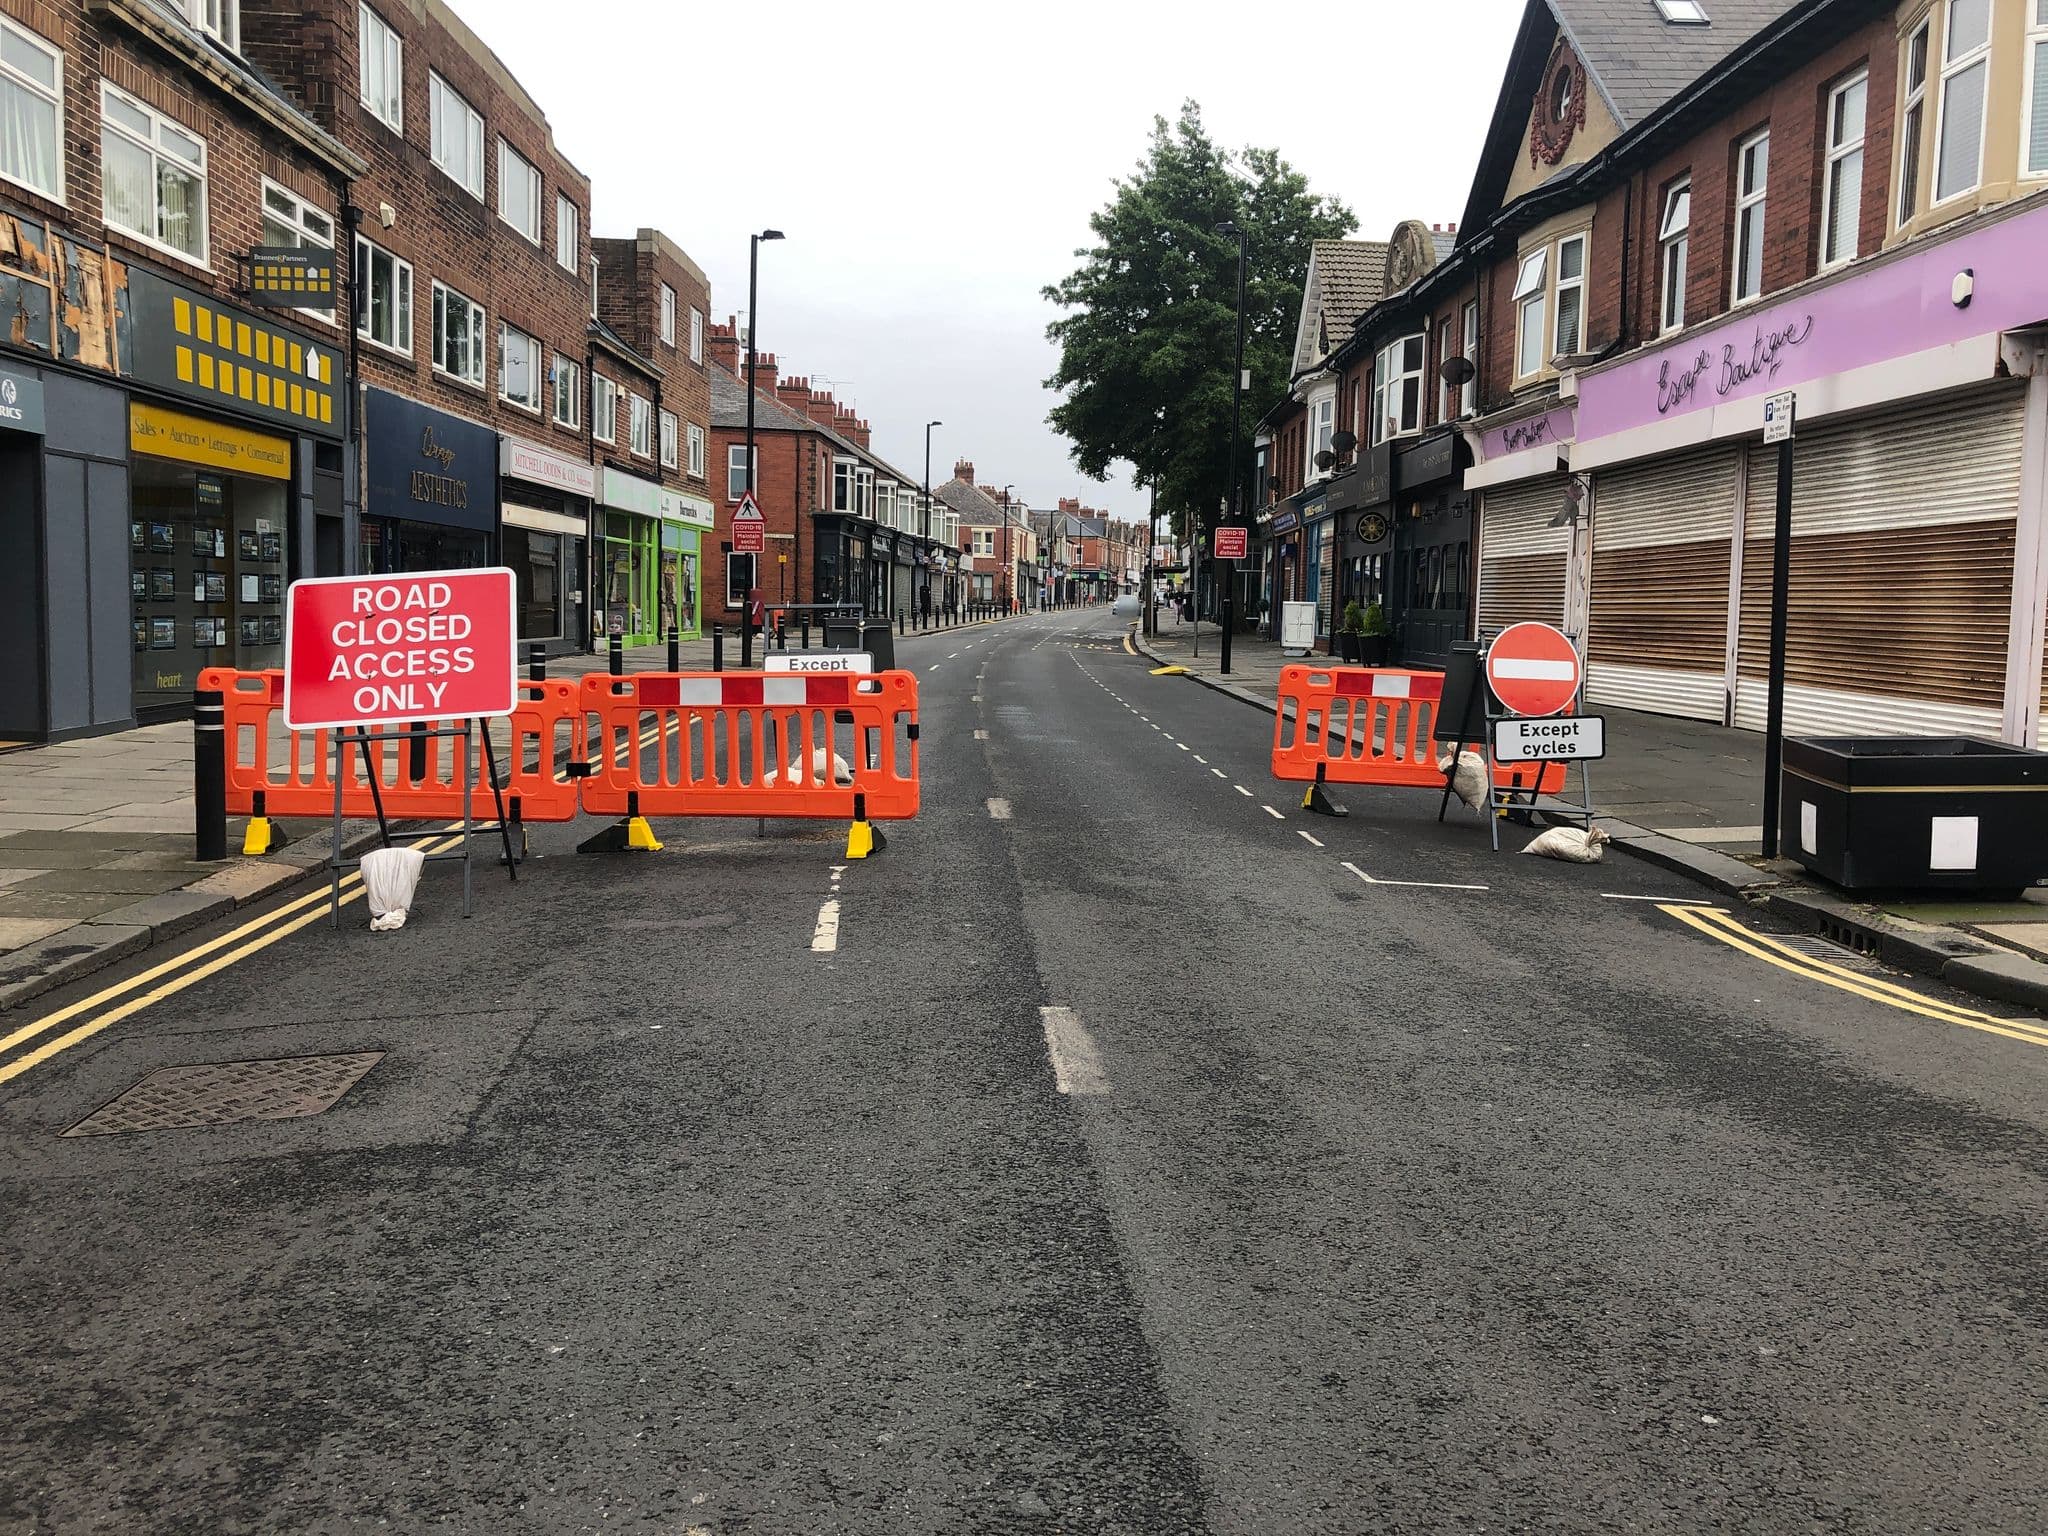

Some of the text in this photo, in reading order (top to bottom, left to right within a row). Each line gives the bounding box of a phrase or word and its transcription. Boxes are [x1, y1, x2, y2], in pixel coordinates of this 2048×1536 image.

[1716, 315, 1812, 396] Boutique
[135, 417, 286, 465] Sales Auction Lettings Commercial
[410, 470, 468, 510] AESTHETICS
[352, 583, 451, 613] ROAD
[331, 614, 472, 648] CLOSED
[156, 671, 182, 688] heart
[327, 646, 475, 682] ACCESS
[789, 657, 849, 672] Except
[352, 681, 449, 714] ONLY
[1520, 722, 1579, 738] Except
[1522, 741, 1577, 757] cycles
